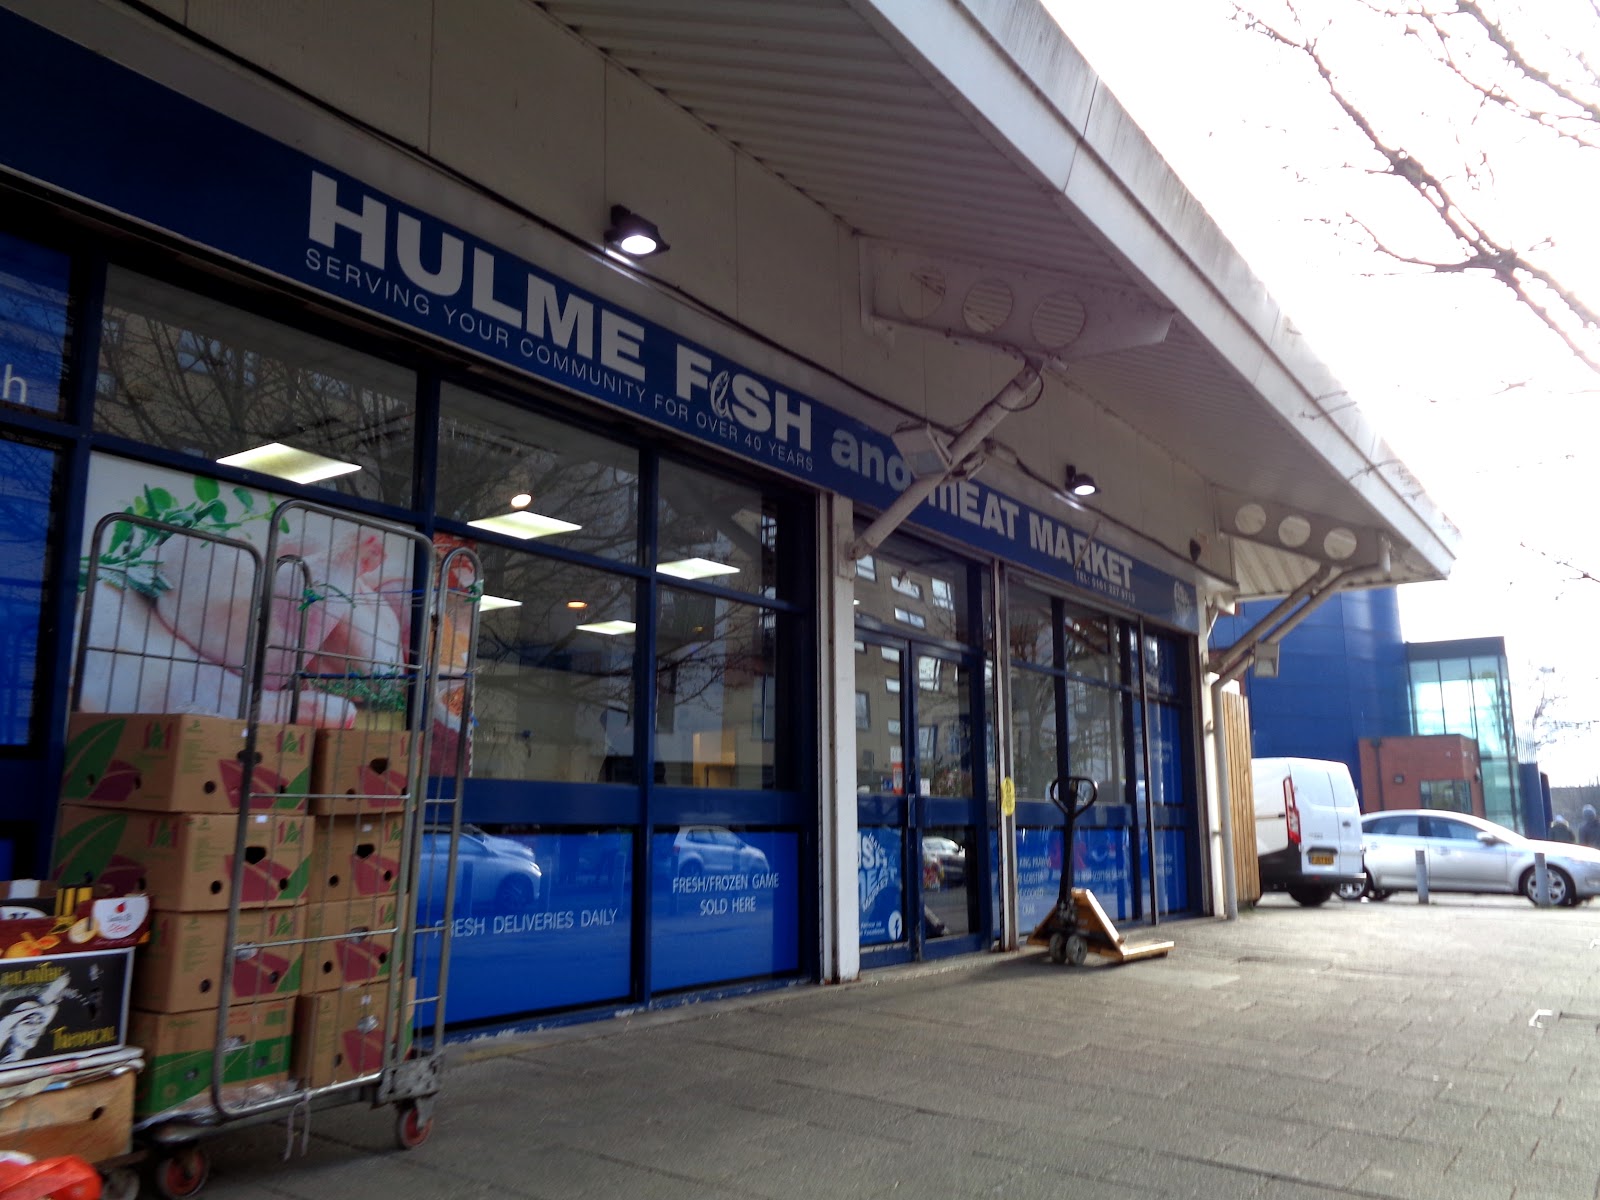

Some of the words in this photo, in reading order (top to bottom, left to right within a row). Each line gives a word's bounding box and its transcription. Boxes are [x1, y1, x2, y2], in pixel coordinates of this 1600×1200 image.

[308, 171, 646, 381] HULME
[676, 343, 812, 452] FISH
[305, 247, 430, 316] SERVING
[443, 302, 509, 349] YOUR
[520, 337, 646, 404] COMMUNITY
[655, 393, 688, 422] FOR
[696, 411, 738, 442] OVER
[744, 433, 762, 451] 40
[768, 440, 813, 472] YEARS
[1029, 512, 1133, 590] MARKET
[672, 875, 748, 894] FRESH/FROZEN
[752, 872, 780, 889] GAME
[700, 897, 728, 916] SOLD
[731, 895, 756, 913] HERE
[493, 911, 574, 935] DELIVERIES
[581, 908, 618, 928] DAILY
